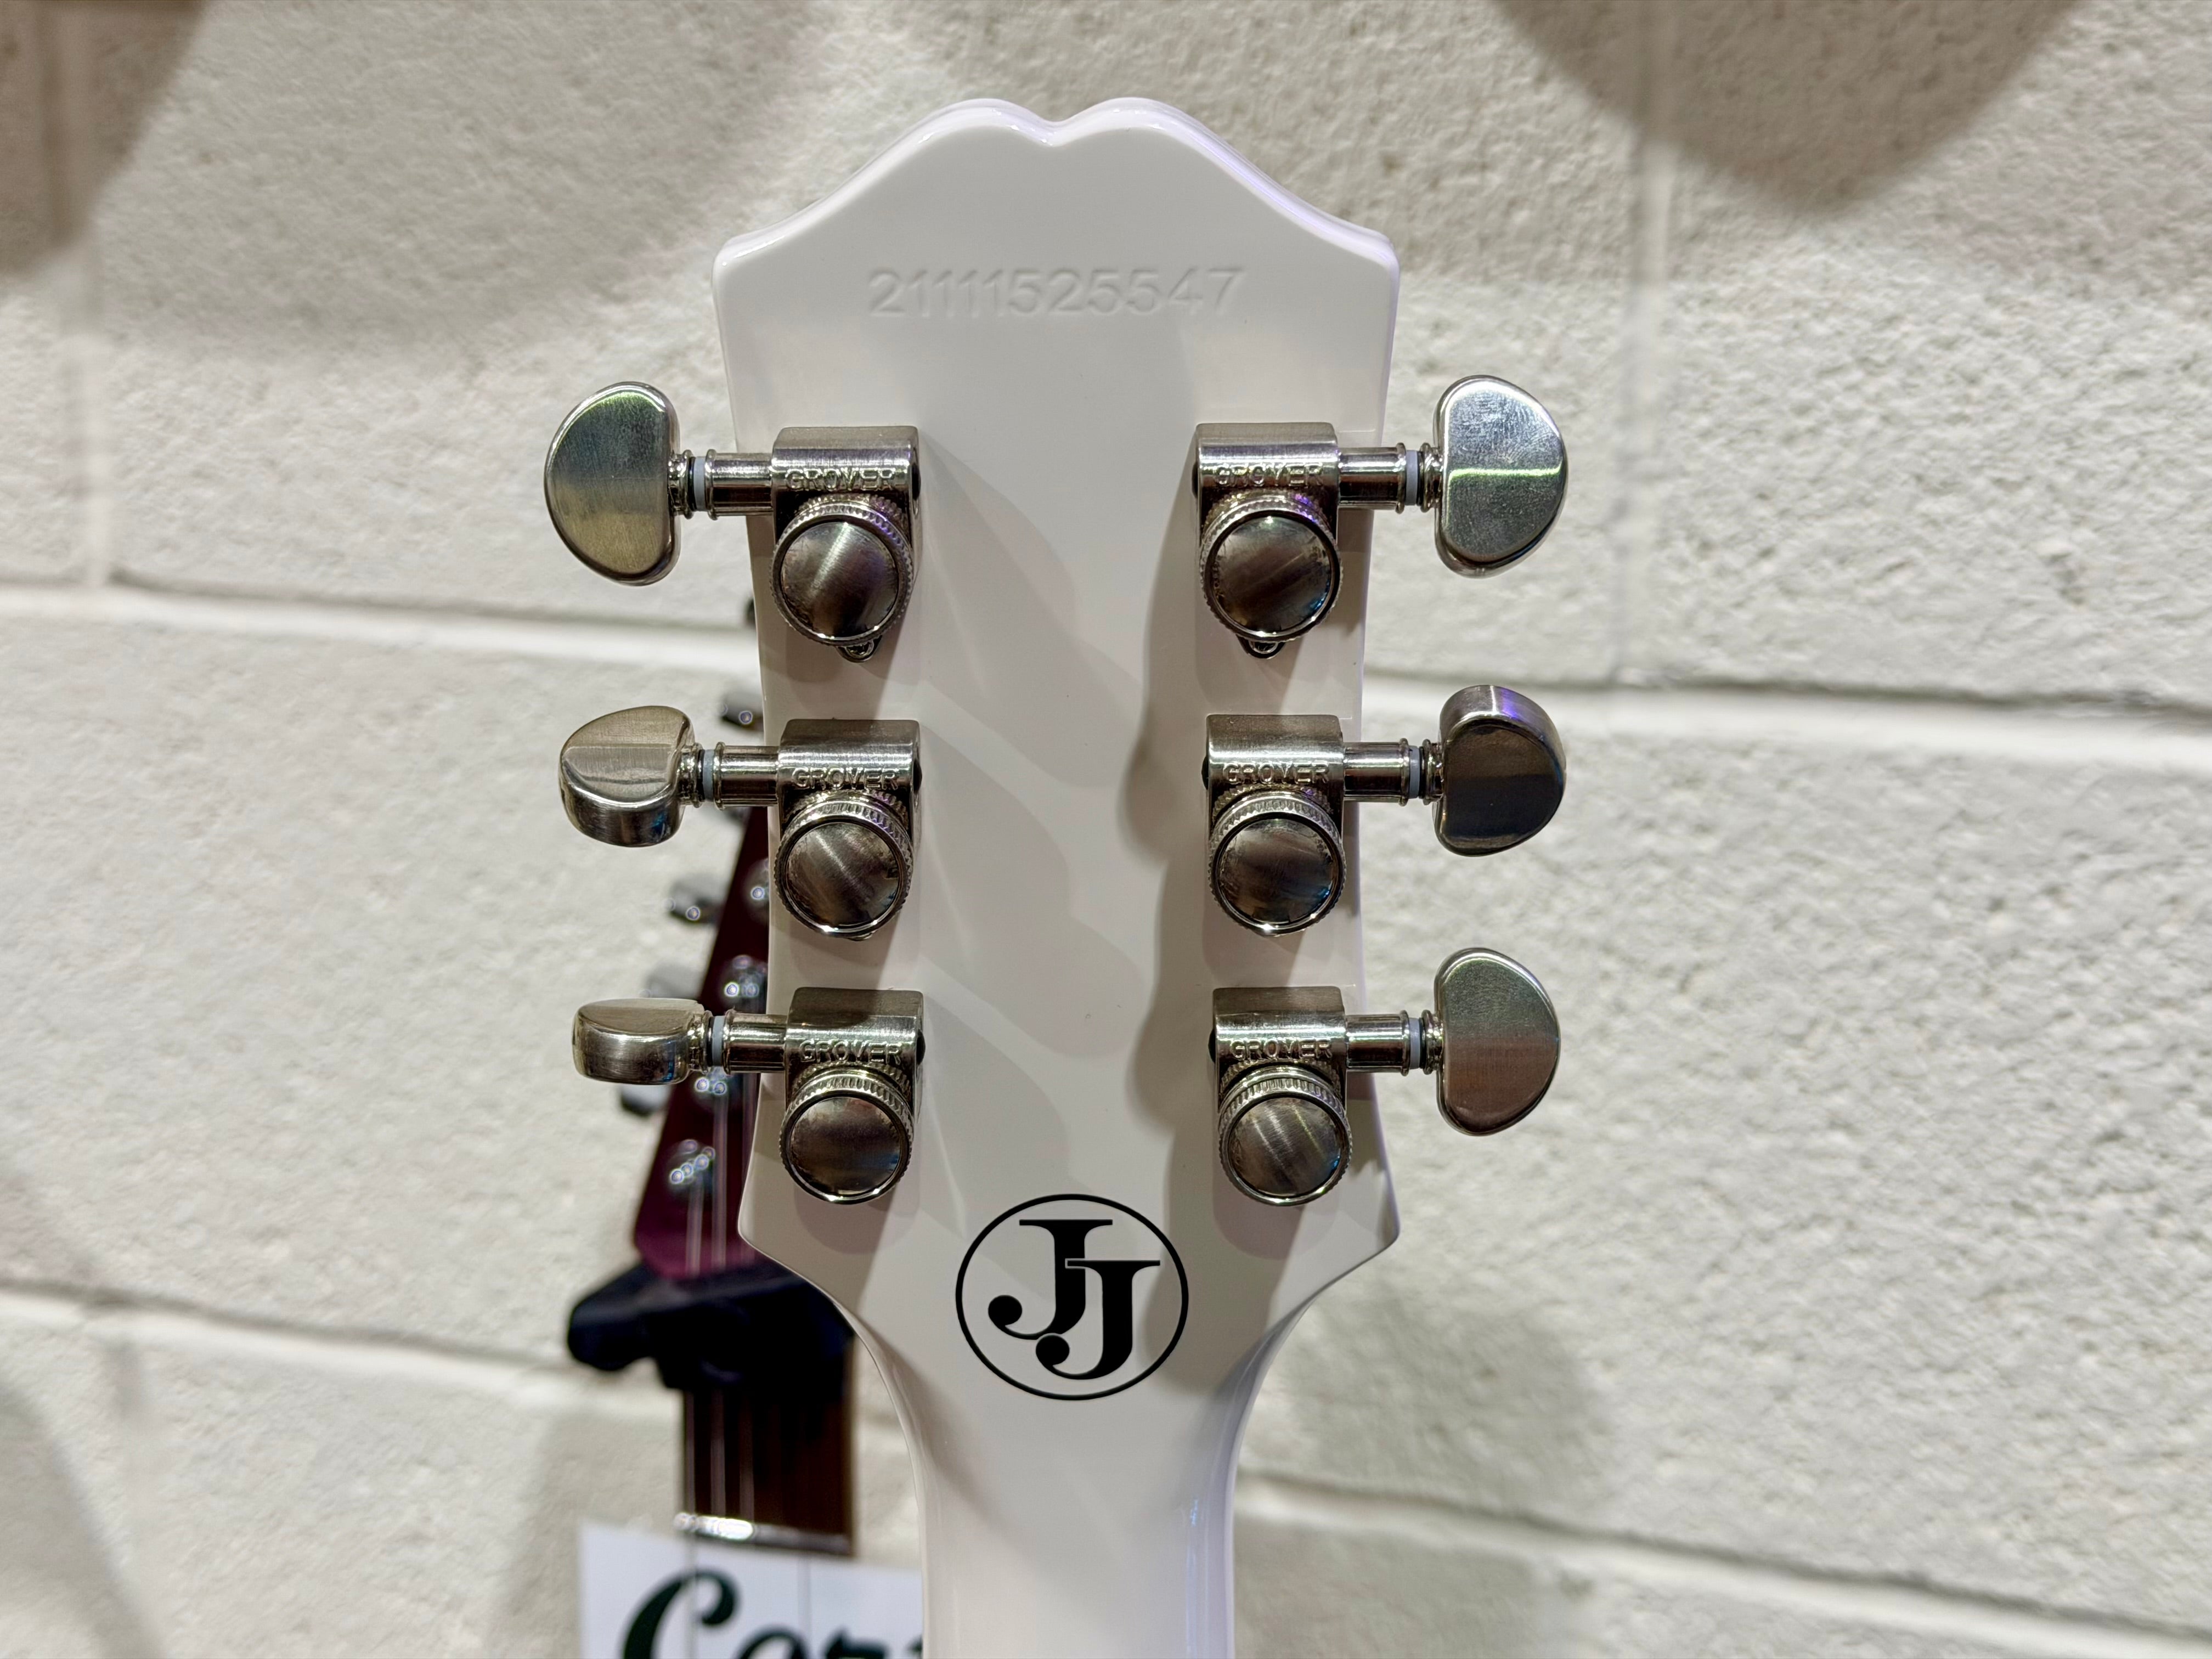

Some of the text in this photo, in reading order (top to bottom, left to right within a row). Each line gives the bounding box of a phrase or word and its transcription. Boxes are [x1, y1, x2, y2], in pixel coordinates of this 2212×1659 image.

[868, 267, 1244, 317] 21111525547
[785, 467, 895, 491] GROVER
[1214, 462, 1323, 488] GROVER
[792, 766, 899, 791] GROVER
[1222, 760, 1329, 785] GROVER
[799, 1039, 902, 1065] GROVER
[1230, 1036, 1333, 1060] GROVER
[988, 1219, 1161, 1380] JJ
